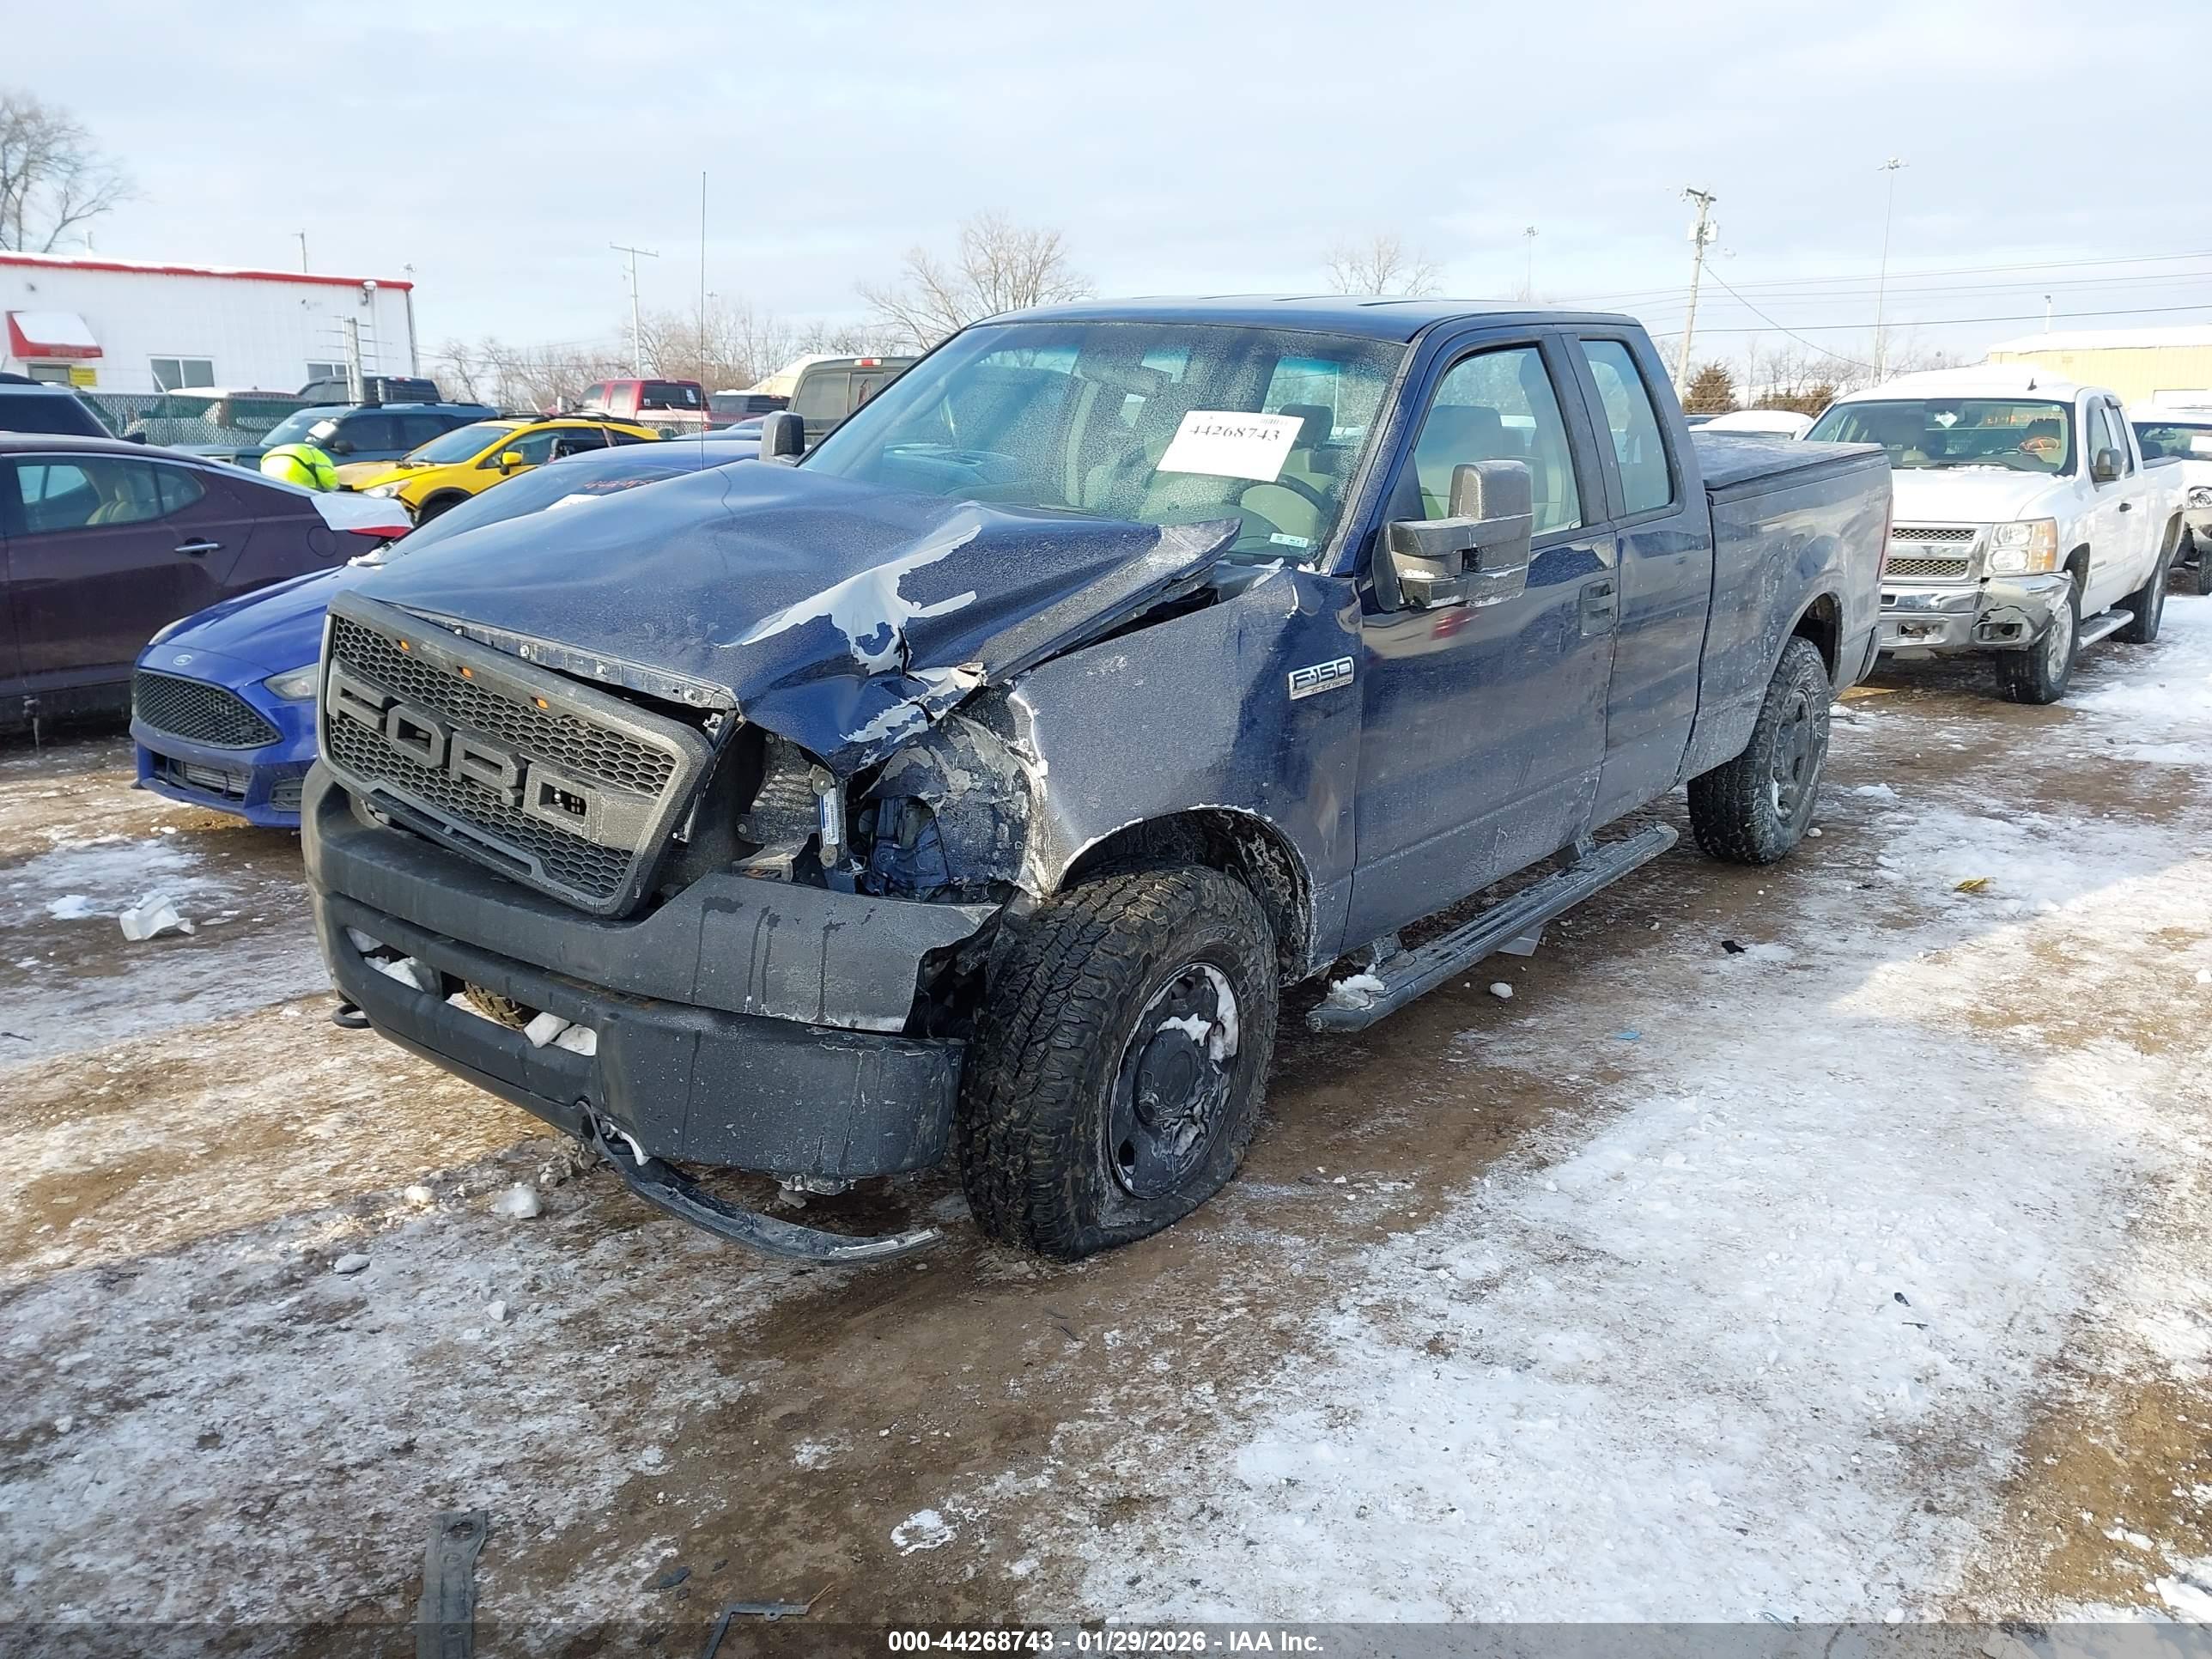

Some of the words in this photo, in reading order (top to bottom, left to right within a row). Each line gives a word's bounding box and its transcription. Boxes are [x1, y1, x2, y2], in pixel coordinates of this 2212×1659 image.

[1189, 425, 1280, 441] 44268743
[1292, 659, 1352, 689] F-150
[326, 668, 604, 847] FORD
